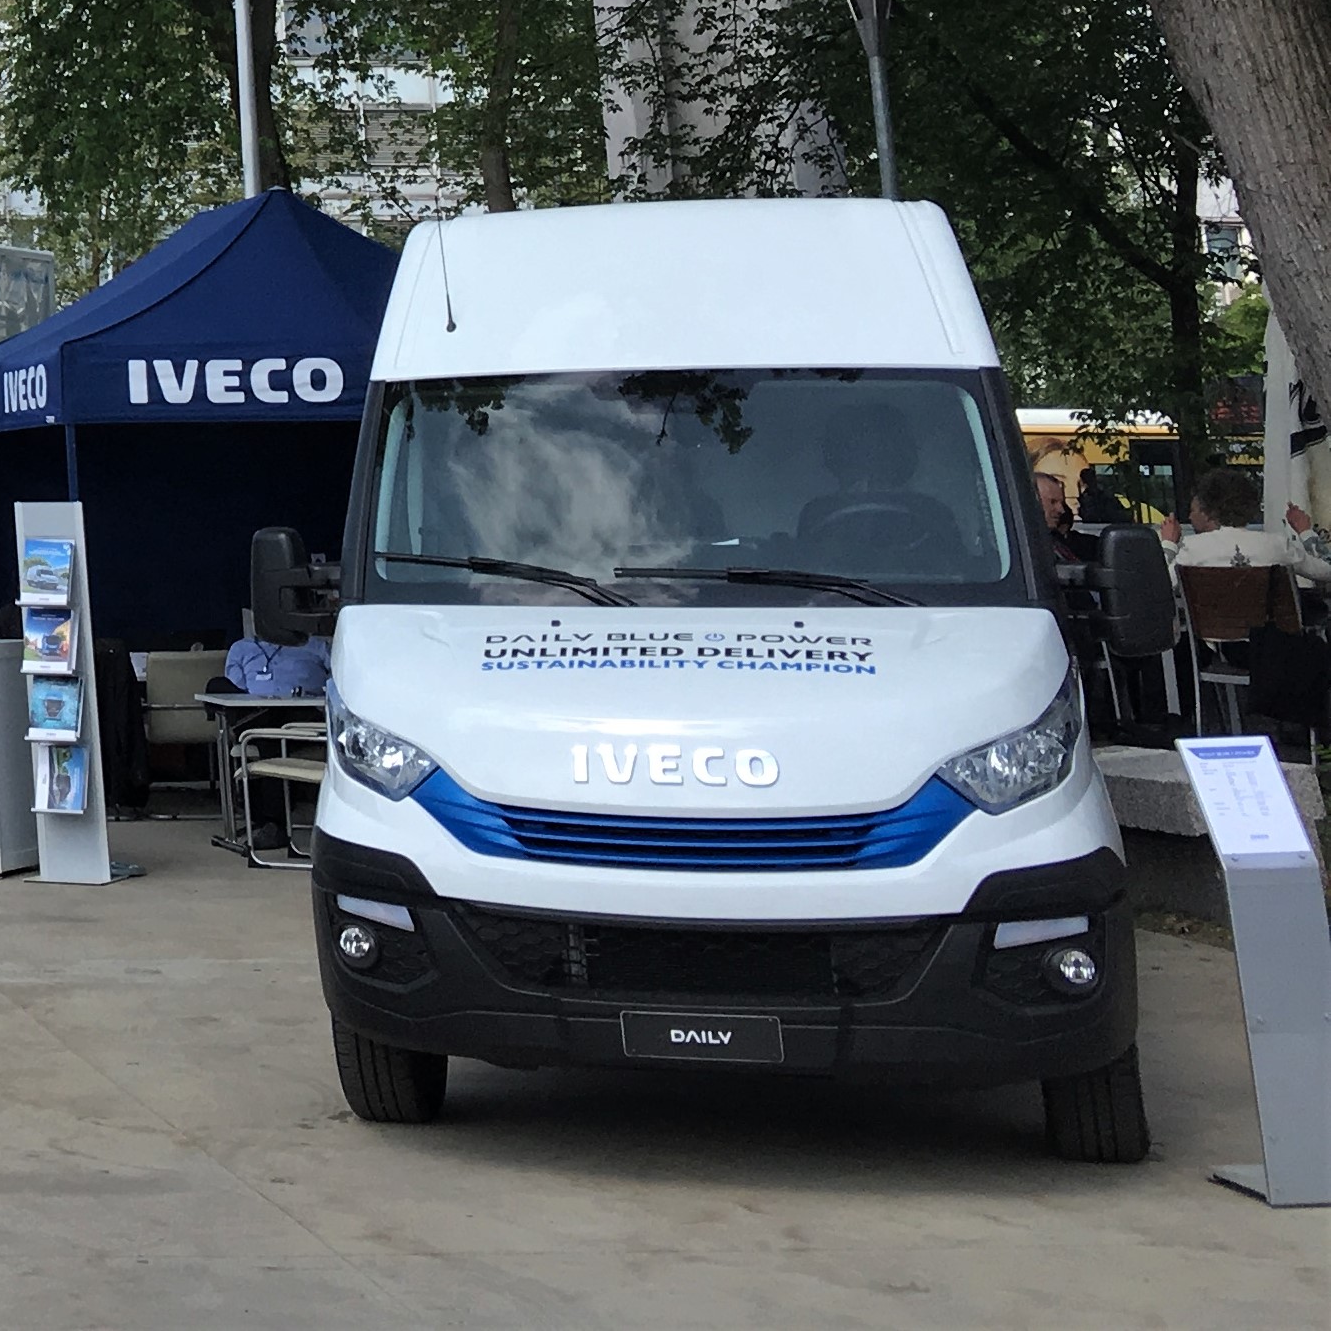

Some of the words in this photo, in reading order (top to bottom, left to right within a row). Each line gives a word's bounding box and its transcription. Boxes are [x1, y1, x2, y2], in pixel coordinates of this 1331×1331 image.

[3, 364, 47, 413] IVECO
[128, 357, 344, 404] IVECO
[486, 633, 593, 643] DAILY
[607, 632, 693, 642] BLUE
[736, 633, 873, 646] POWER
[484, 646, 684, 659] UNLIMITED
[697, 647, 873, 662] DELIVERY
[481, 659, 709, 671] SUSTAINABILITY
[717, 660, 876, 675] CHAMPION
[571, 743, 780, 788] IVECO
[670, 1029, 732, 1045] DAILY
